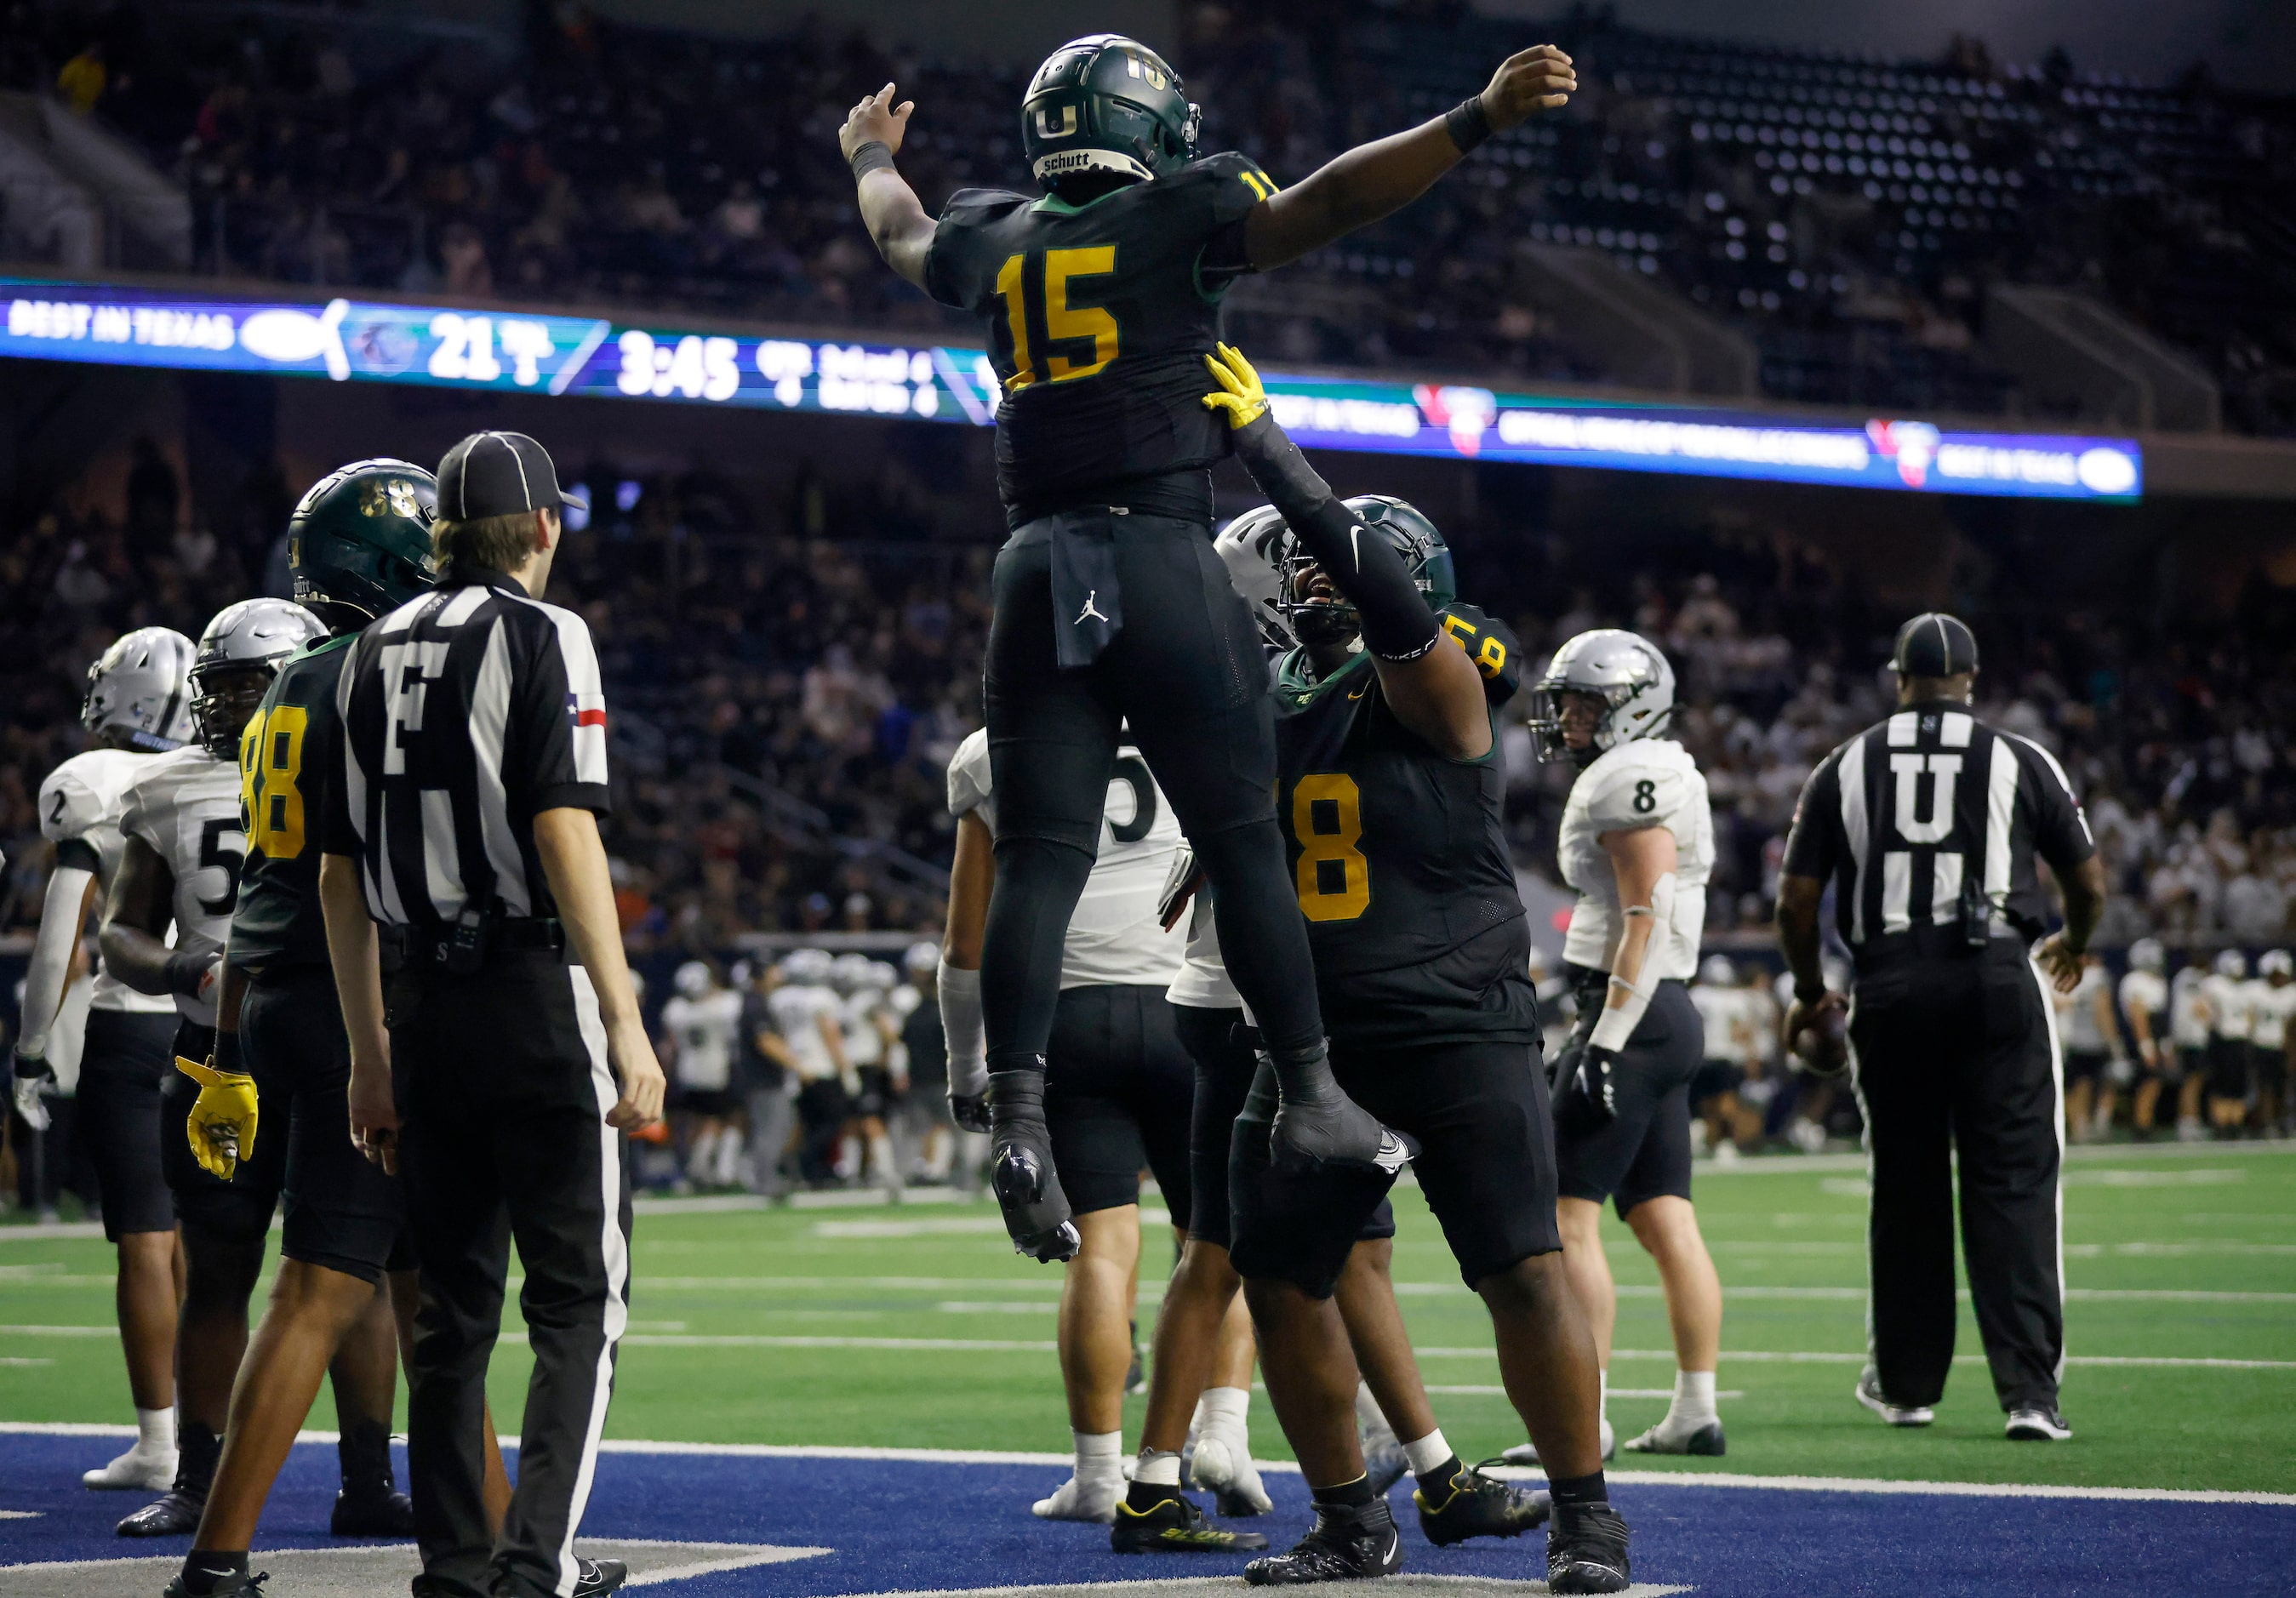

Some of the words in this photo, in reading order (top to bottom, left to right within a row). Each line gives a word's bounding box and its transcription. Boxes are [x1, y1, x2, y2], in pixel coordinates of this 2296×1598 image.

[1044, 152, 1090, 171] schutt
[9, 299, 91, 340] BEST
[92, 304, 131, 342] IN
[132, 307, 235, 351] TEXAS
[428, 312, 501, 382] 21
[996, 245, 1119, 391] 15
[617, 329, 740, 402] 3:45
[379, 641, 451, 774] F
[49, 790, 66, 825] 2
[1633, 779, 1656, 813] 8
[1890, 754, 1963, 843] U
[1277, 773, 1370, 922] 8
